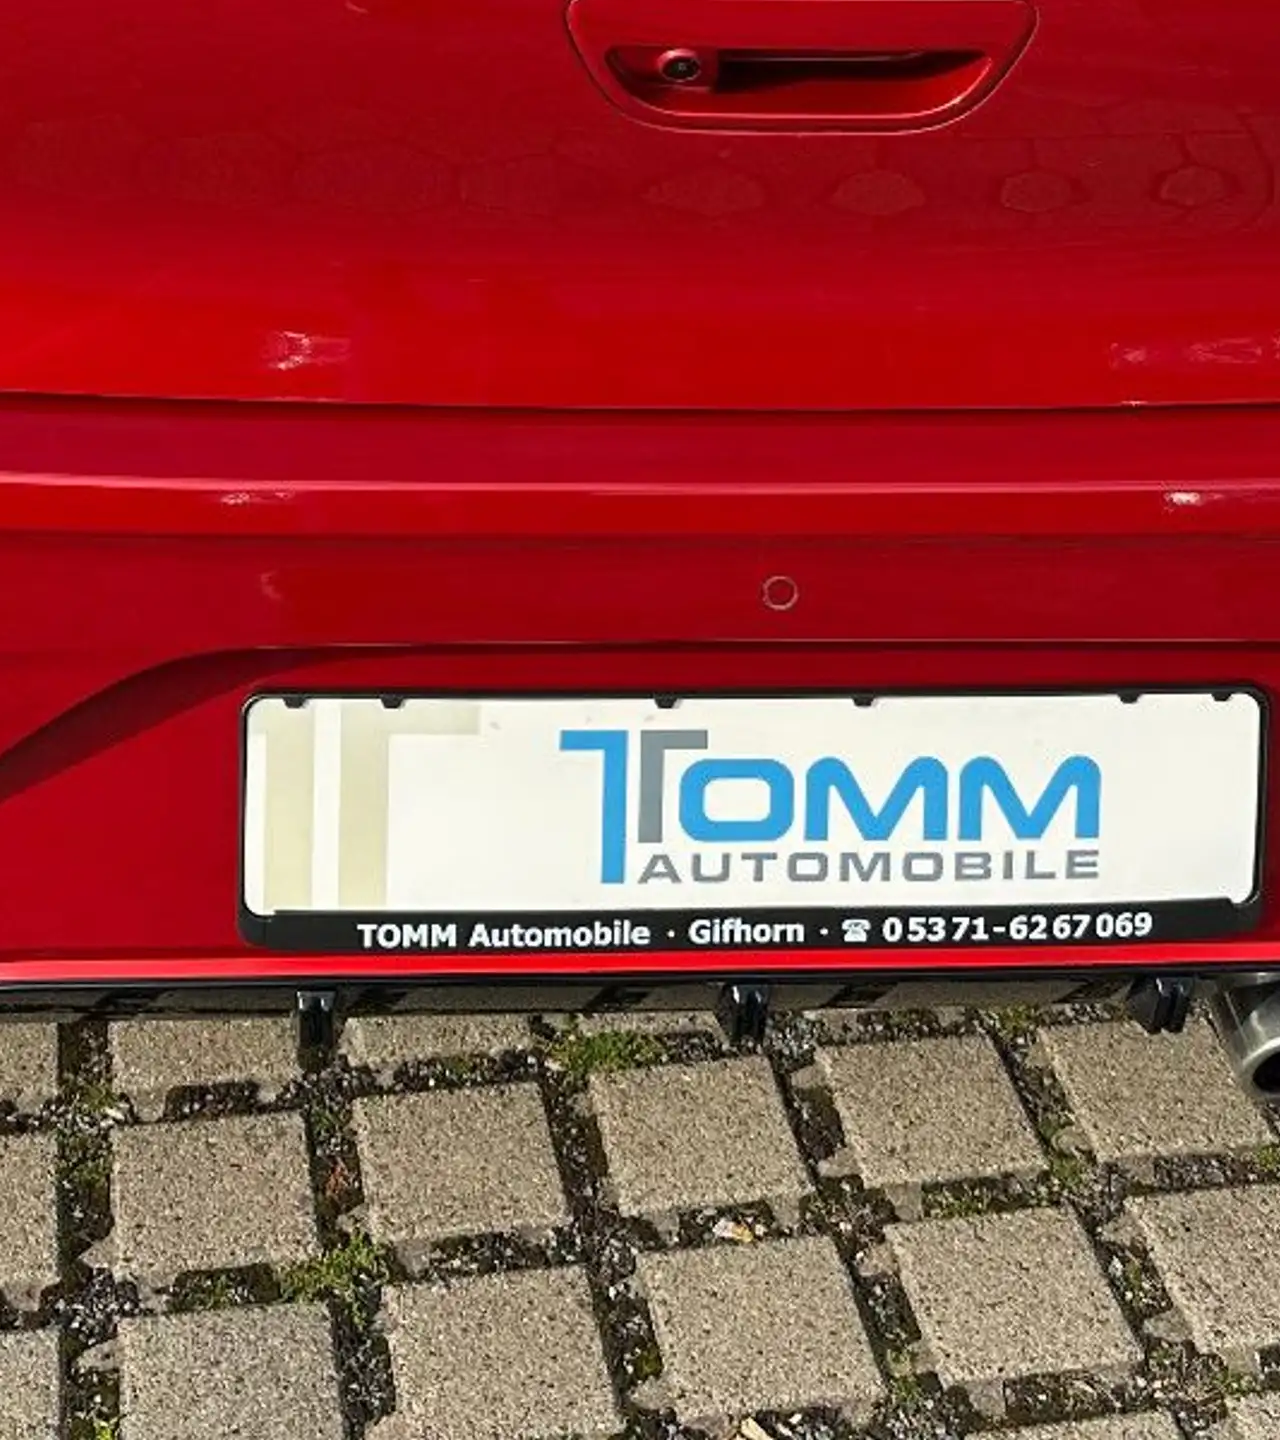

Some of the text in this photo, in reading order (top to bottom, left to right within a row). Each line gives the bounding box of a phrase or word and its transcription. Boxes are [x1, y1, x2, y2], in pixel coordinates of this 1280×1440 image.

[559, 729, 1102, 884] TOMM
[638, 850, 1100, 884] AUTOMOBILE
[357, 923, 457, 948] TOMM
[467, 920, 651, 947] Automobile
[688, 918, 805, 944] Gifhorn
